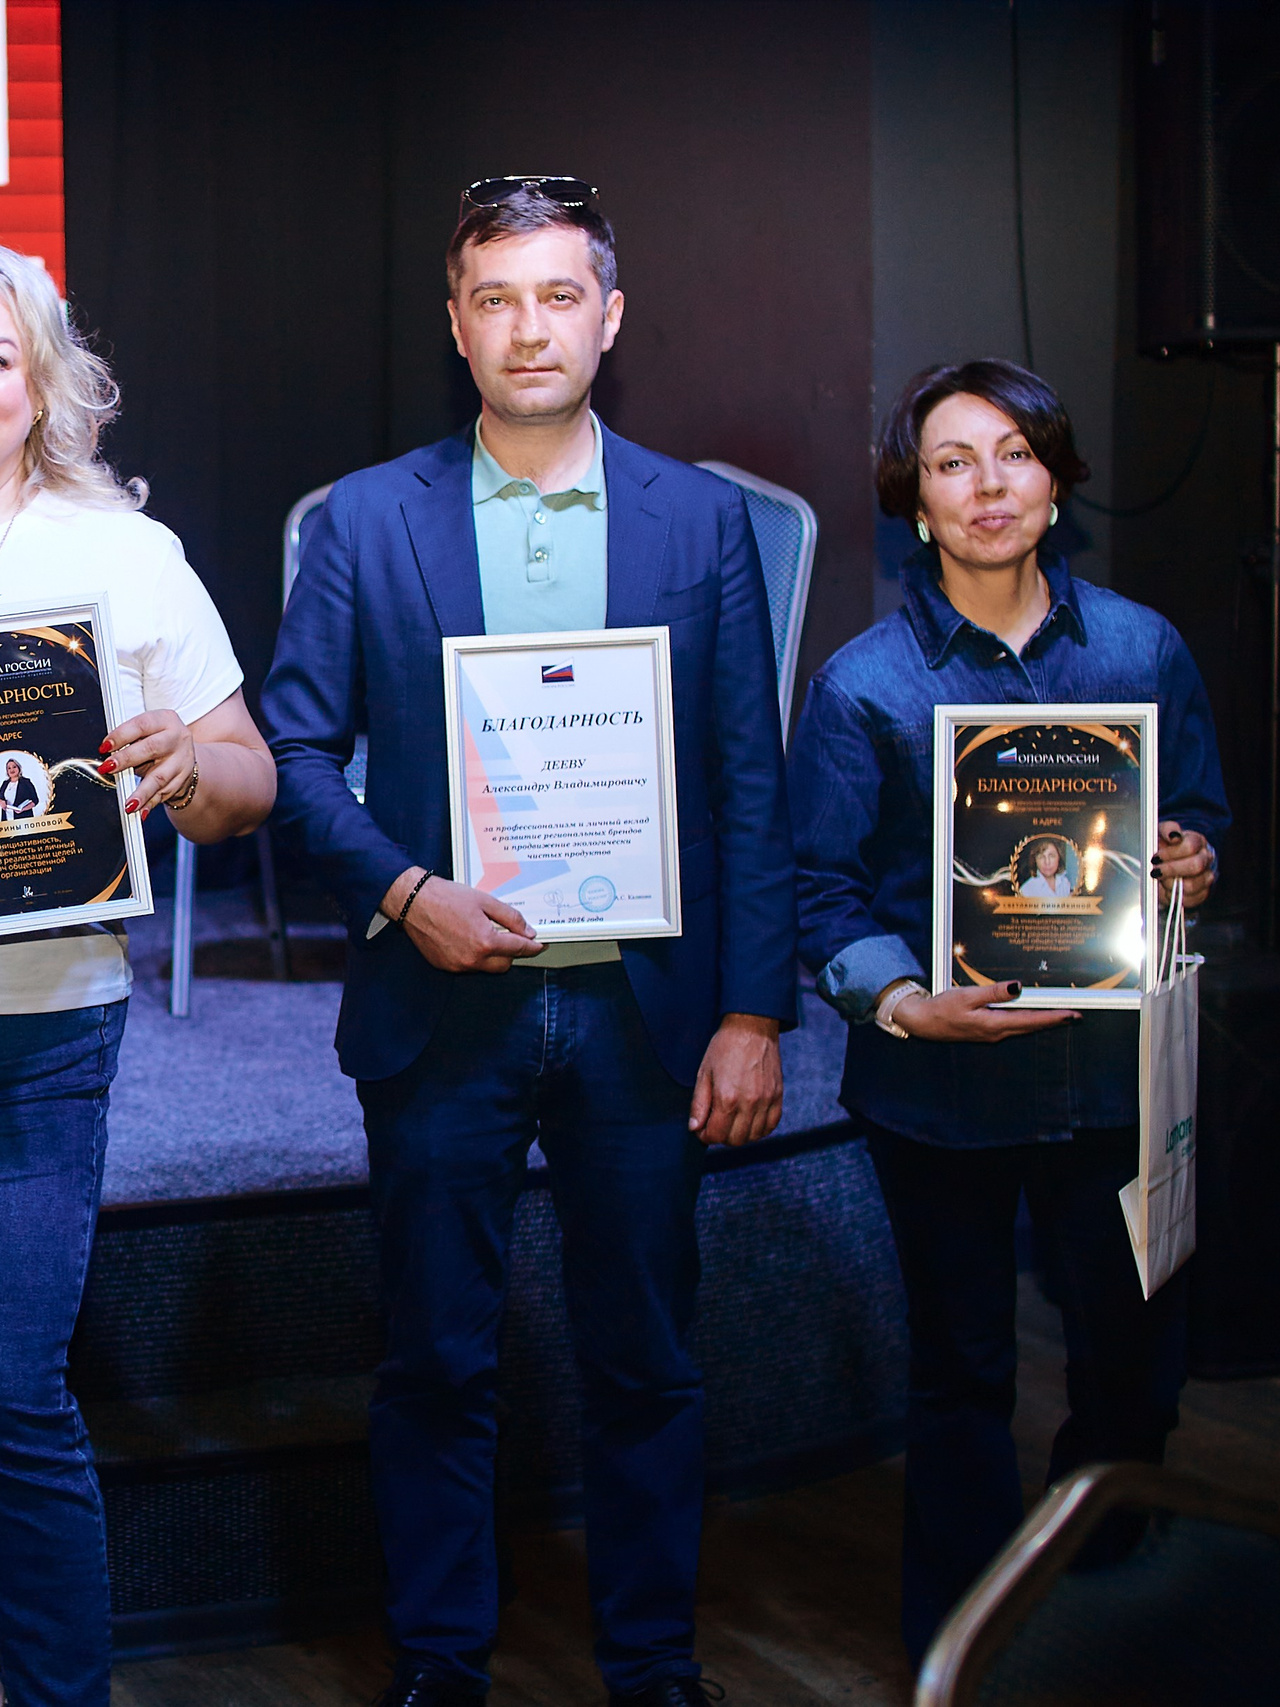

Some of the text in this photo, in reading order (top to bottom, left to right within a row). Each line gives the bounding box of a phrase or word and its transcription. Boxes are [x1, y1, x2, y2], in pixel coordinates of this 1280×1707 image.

[5, 658, 51, 674] РОССИИ
[481, 711, 643, 733] БЛАГОДАРНОСТЬ
[540, 759, 587, 772] ДЕЕВУ
[1018, 753, 1100, 764] ОПОРА РОССИИ
[482, 777, 648, 794] Александру Владимировичу
[977, 777, 1118, 795] БЛАГОДАРНОСТЬ
[24, 818, 63, 829] ПОПОВОЙ
[496, 822, 576, 834] профессионализм
[44, 840, 75, 851] личный
[4, 852, 51, 865] реализации
[52, 848, 76, 858] целей
[8, 856, 66, 871] общественной
[0, 867, 52, 879] организации
